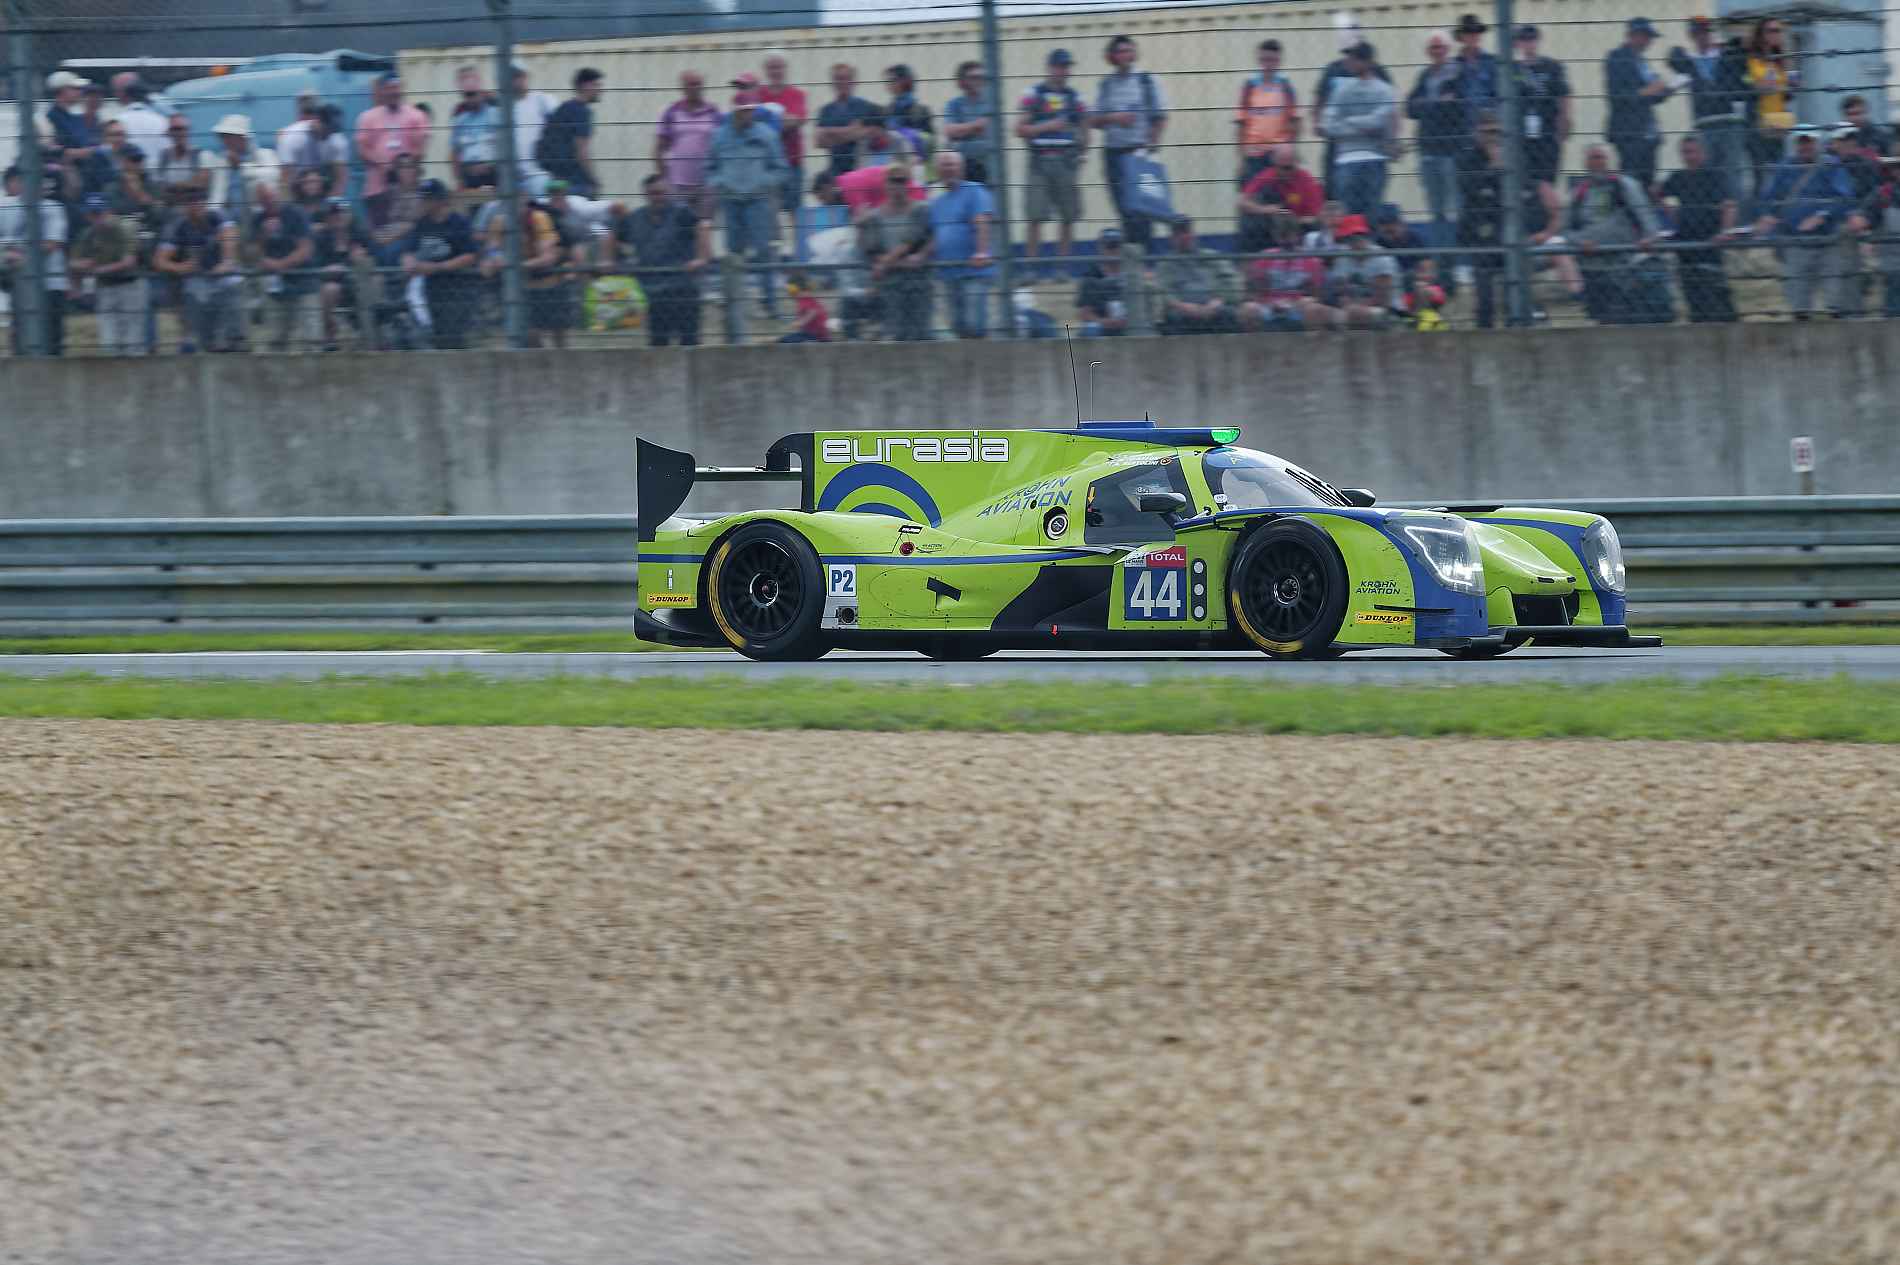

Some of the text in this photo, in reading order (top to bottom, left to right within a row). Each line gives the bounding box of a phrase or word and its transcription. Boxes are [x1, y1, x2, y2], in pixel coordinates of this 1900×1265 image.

[822, 430, 1009, 463] eurasia
[1150, 553, 1185, 561] TOTAL
[831, 569, 854, 592] P2
[1360, 580, 1397, 588] KROHN
[1130, 570, 1182, 617] 44
[1356, 587, 1401, 595] AVIATION
[1364, 614, 1408, 623] DUNLOP
